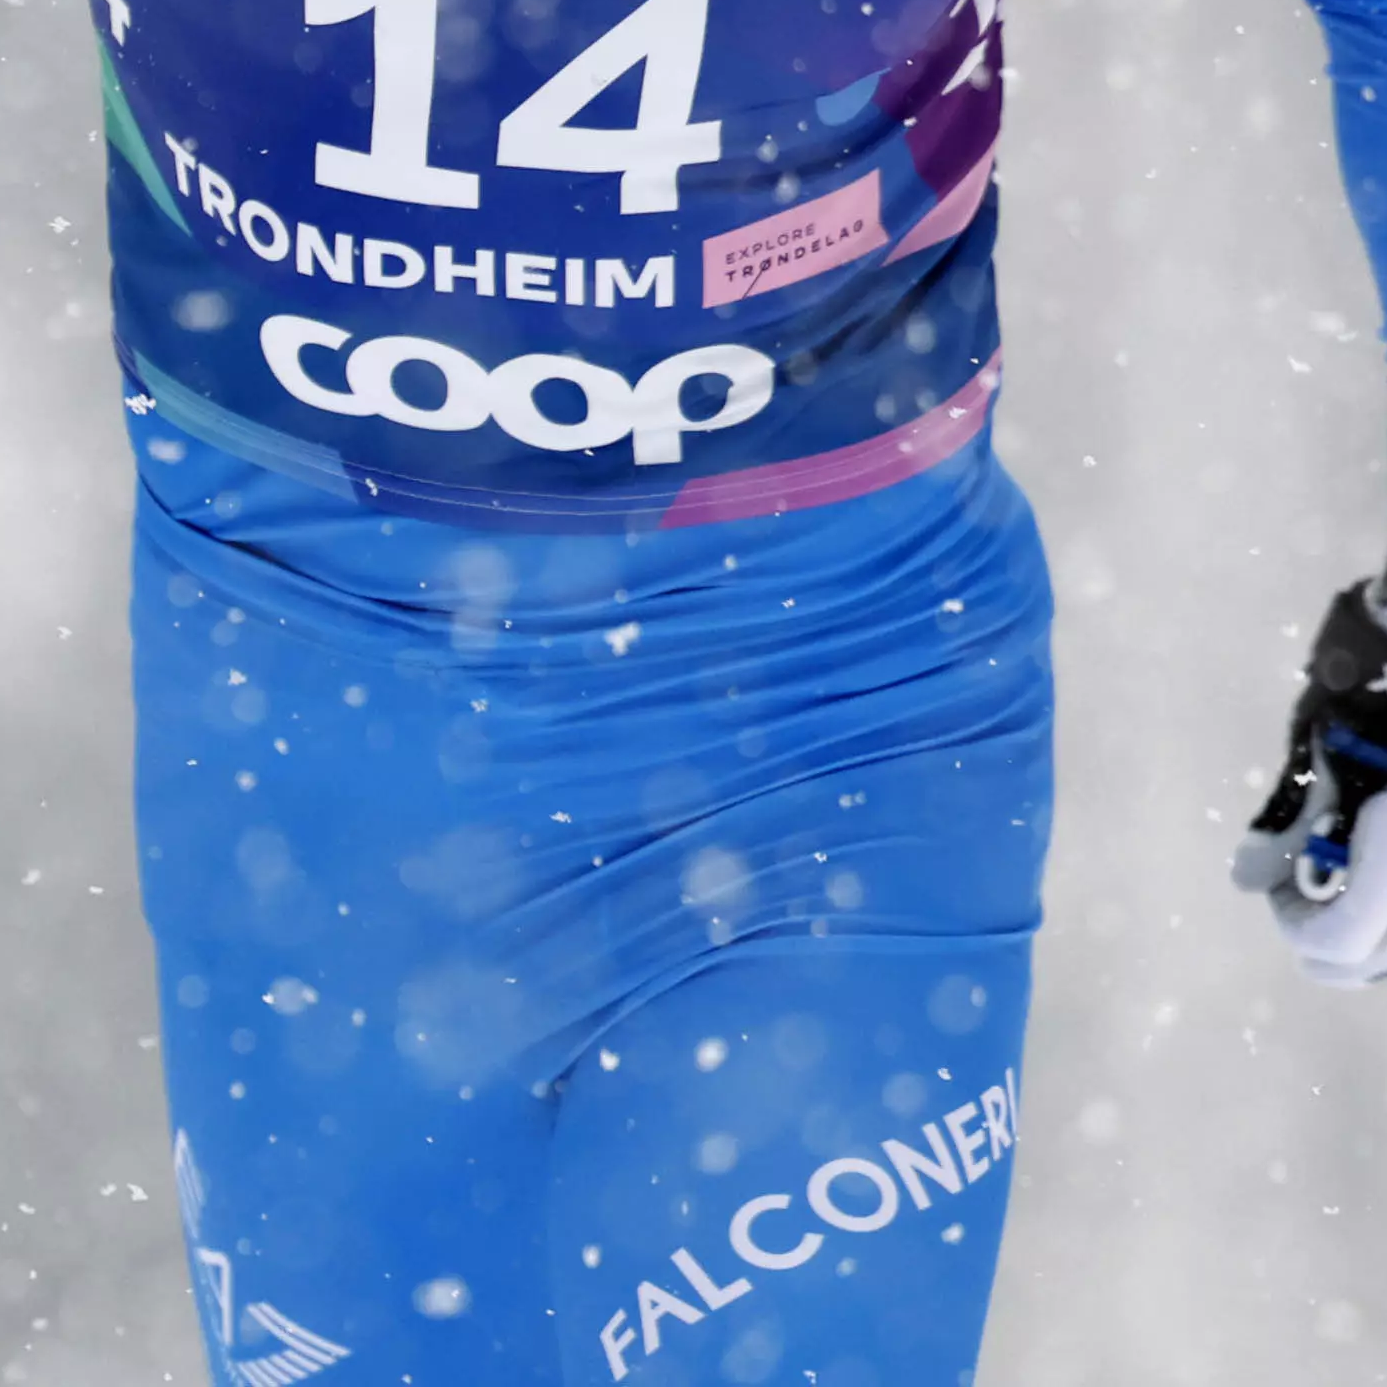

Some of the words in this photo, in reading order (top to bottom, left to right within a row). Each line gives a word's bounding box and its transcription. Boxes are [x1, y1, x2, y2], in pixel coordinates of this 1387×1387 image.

[164, 131, 676, 309] TRONDHEIM
[725, 223, 817, 265] EXPLORE
[259, 314, 777, 465] coop
[599, 1067, 1017, 1382] FALCONERI
